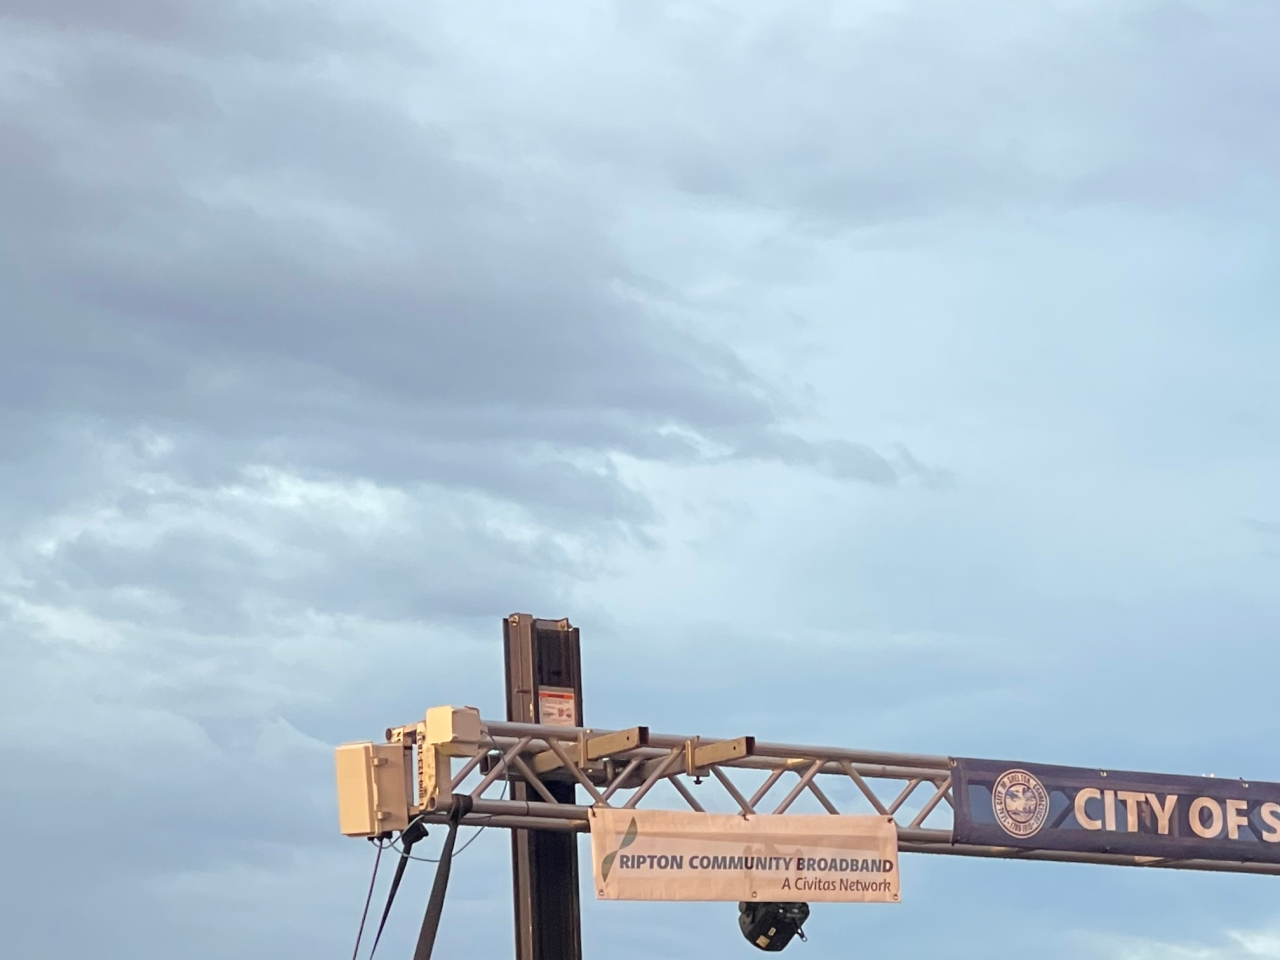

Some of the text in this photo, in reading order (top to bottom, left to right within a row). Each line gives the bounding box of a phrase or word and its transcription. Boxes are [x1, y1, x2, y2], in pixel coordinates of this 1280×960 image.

[1074, 787, 1179, 835] CITY
[1188, 797, 1249, 840] OF
[619, 854, 894, 874] RIPTON COMMUNITY BROADBAND
[781, 877, 891, 893] A Civitas Network
